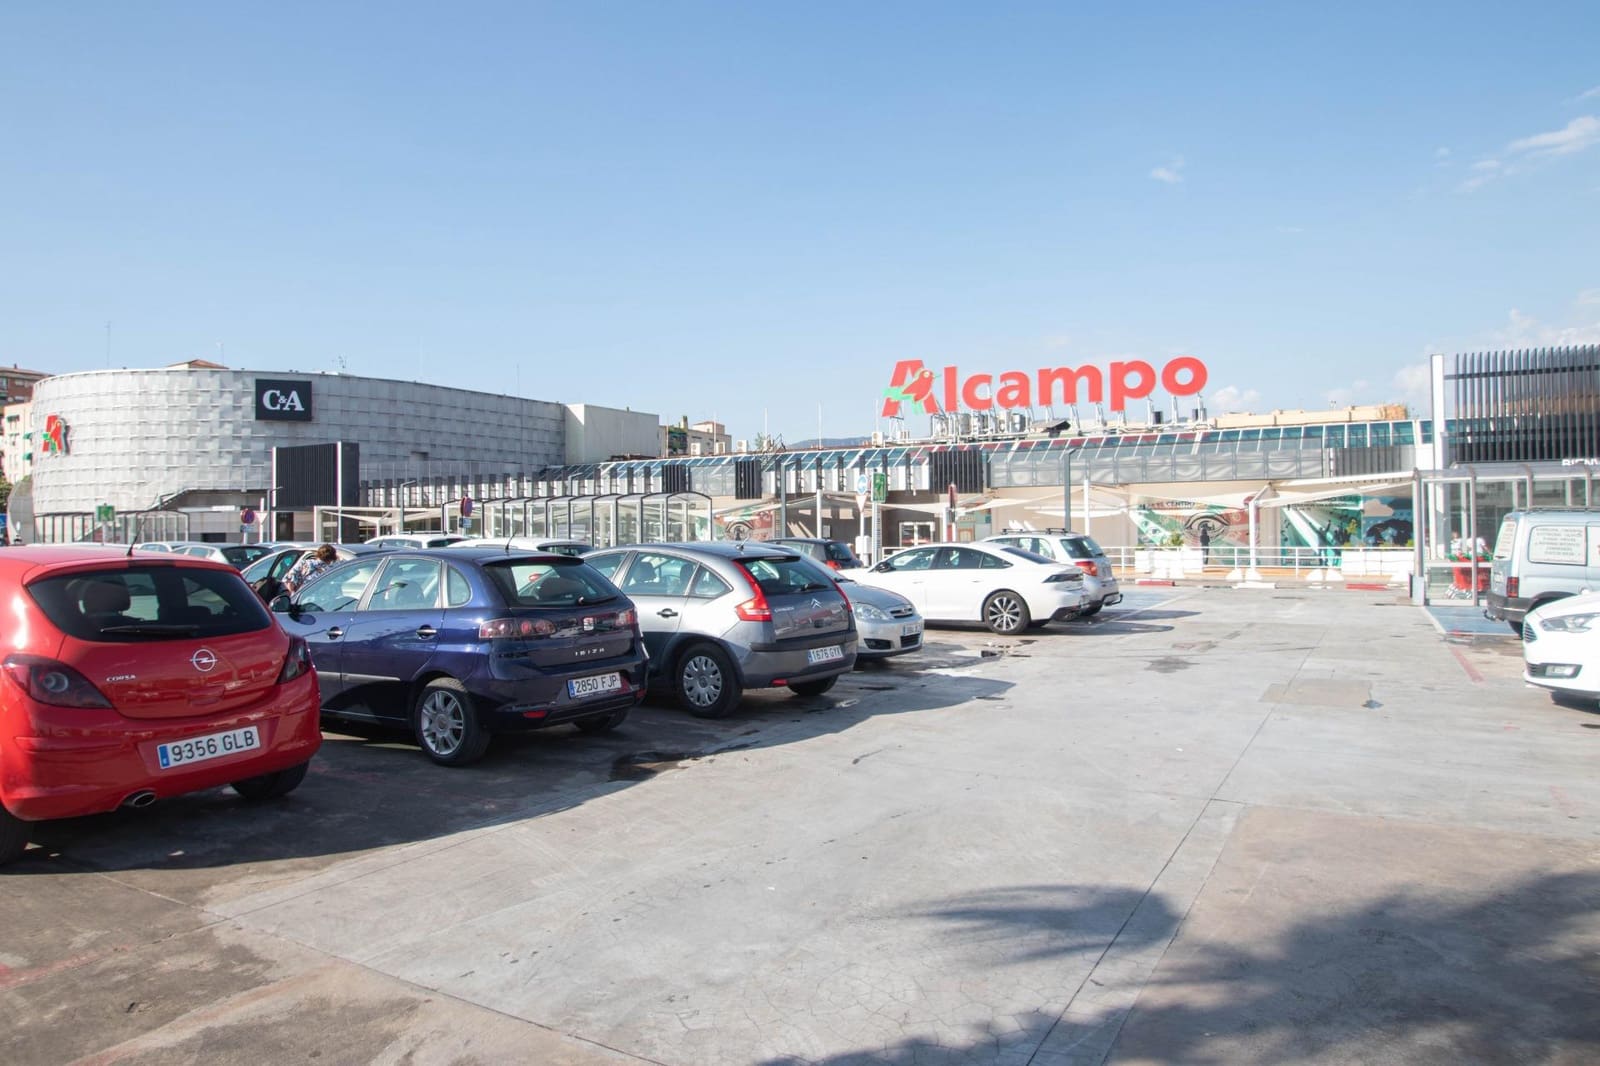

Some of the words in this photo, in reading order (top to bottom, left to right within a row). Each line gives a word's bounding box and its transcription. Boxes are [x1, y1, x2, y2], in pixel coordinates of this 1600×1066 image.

[262, 389, 305, 411] C&A
[882, 357, 1208, 417] Alcampo
[575, 678, 598, 693] 2850
[601, 675, 617, 688] FJP
[172, 738, 217, 762] 9356
[222, 730, 255, 751] GLB
